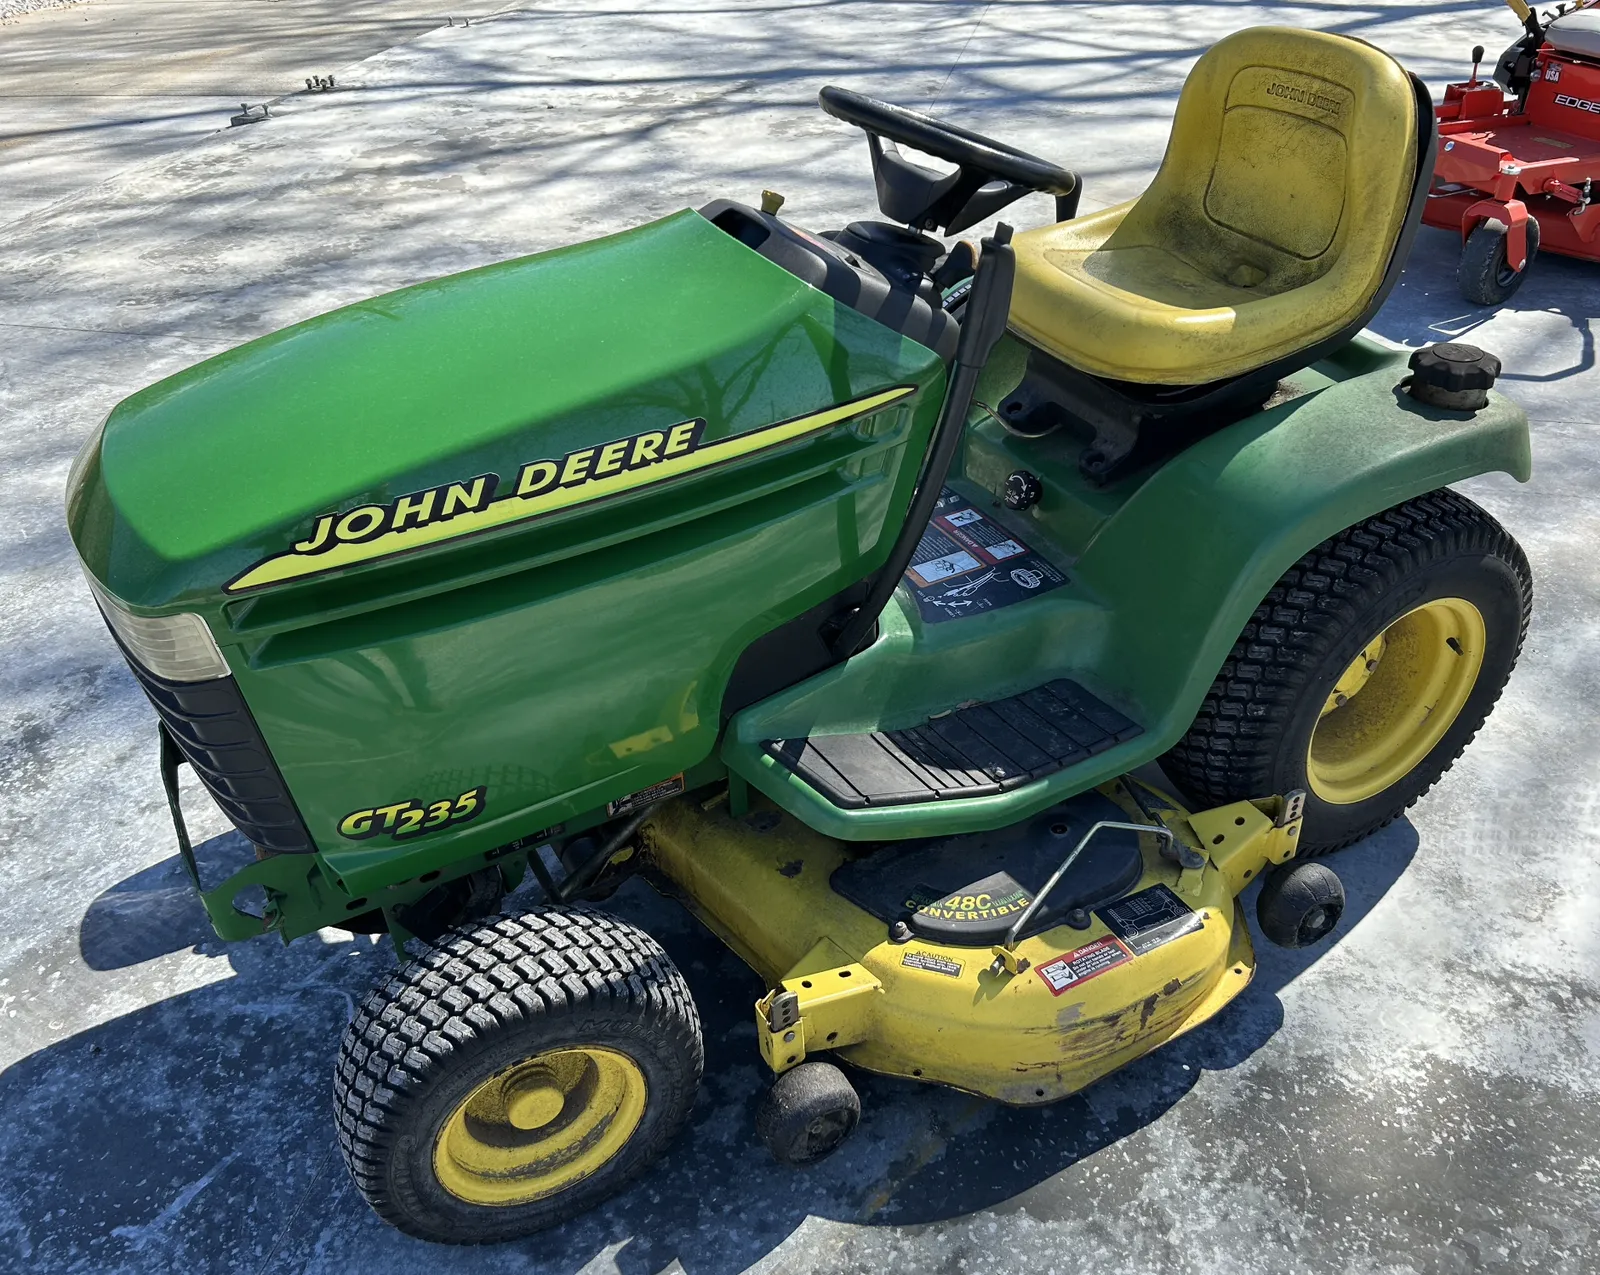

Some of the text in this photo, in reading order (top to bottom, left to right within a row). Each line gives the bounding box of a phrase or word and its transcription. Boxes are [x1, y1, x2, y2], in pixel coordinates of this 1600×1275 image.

[1545, 70, 1559, 82] USA
[1266, 83, 1305, 103] JOHN
[1555, 94, 1600, 114] EDGE
[295, 421, 696, 552] JOHN DEERE
[341, 790, 477, 835] GT235
[906, 897, 1030, 920] CONVERTIBLE
[945, 894, 991, 911] 48C
[922, 951, 954, 962] CAUTION
[1078, 940, 1103, 956] DANGER
